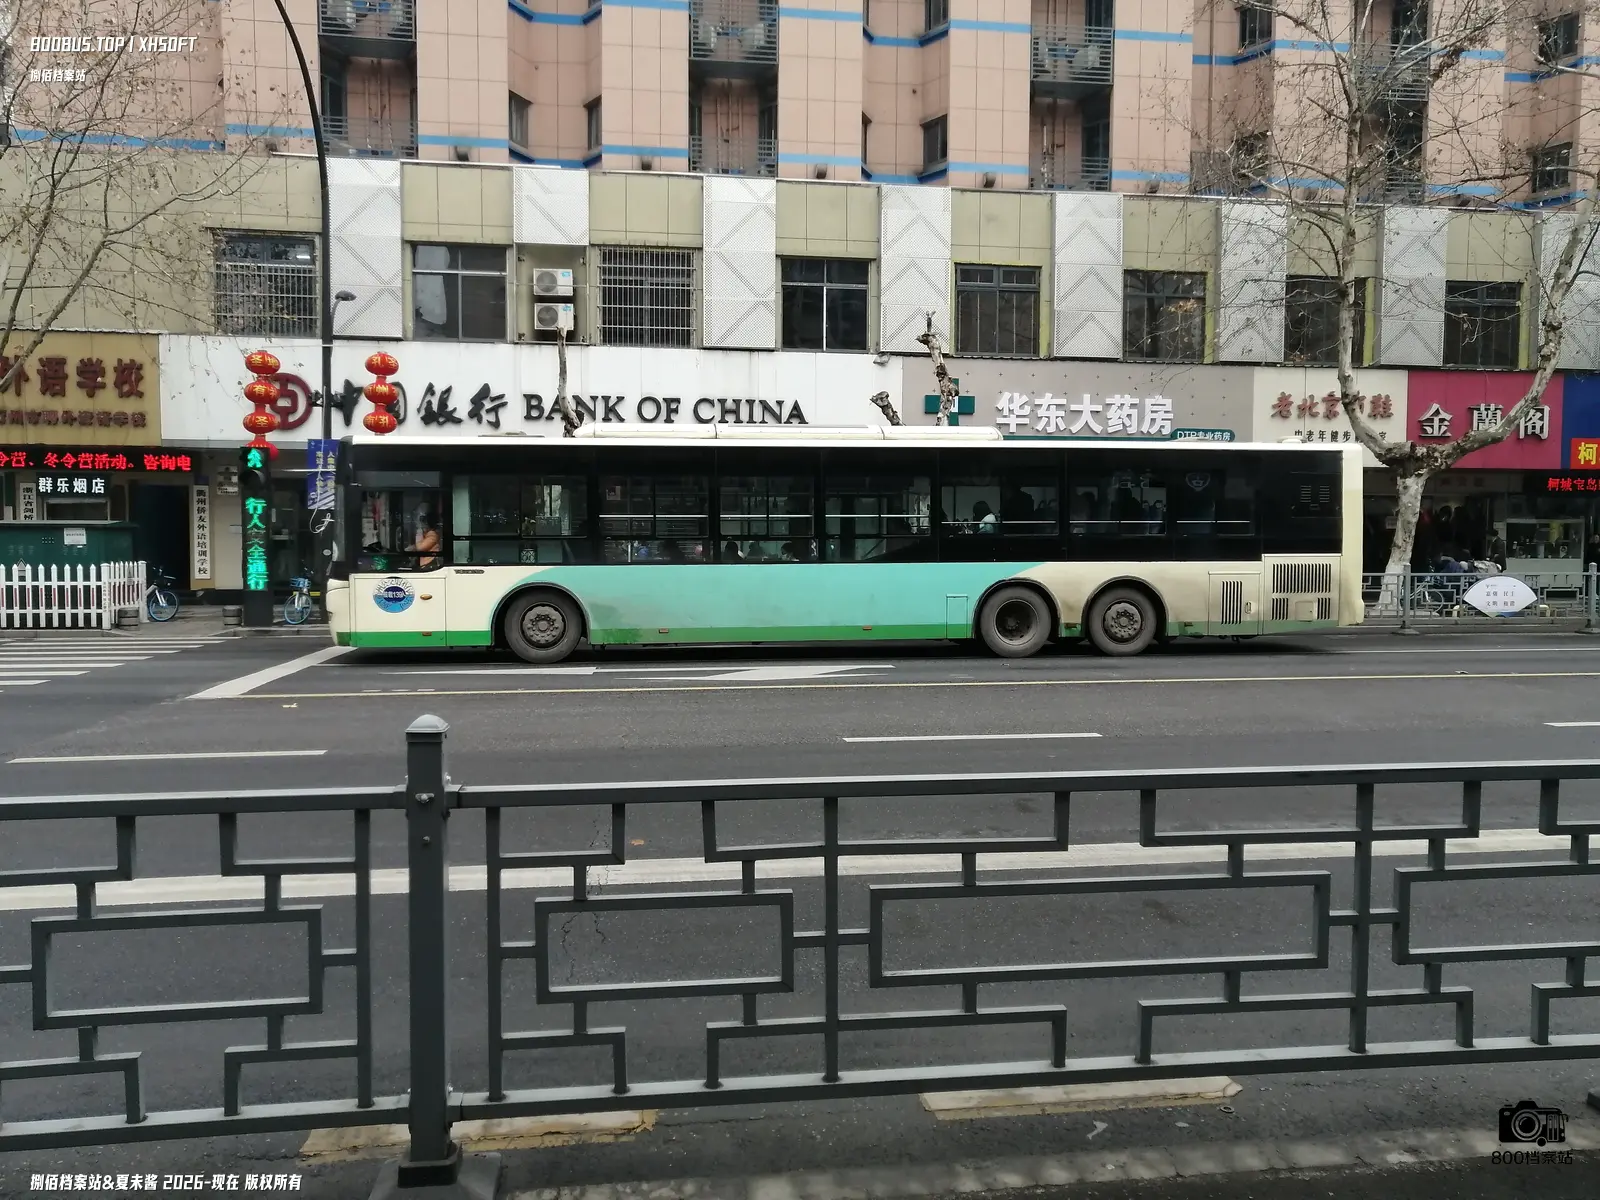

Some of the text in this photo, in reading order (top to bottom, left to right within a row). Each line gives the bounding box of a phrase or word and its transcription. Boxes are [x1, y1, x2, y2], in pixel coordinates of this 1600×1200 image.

[522, 393, 809, 425] BANK OF CHINA
[995, 391, 1174, 435] 华东大药房
[38, 477, 105, 494] 群乐烟店
